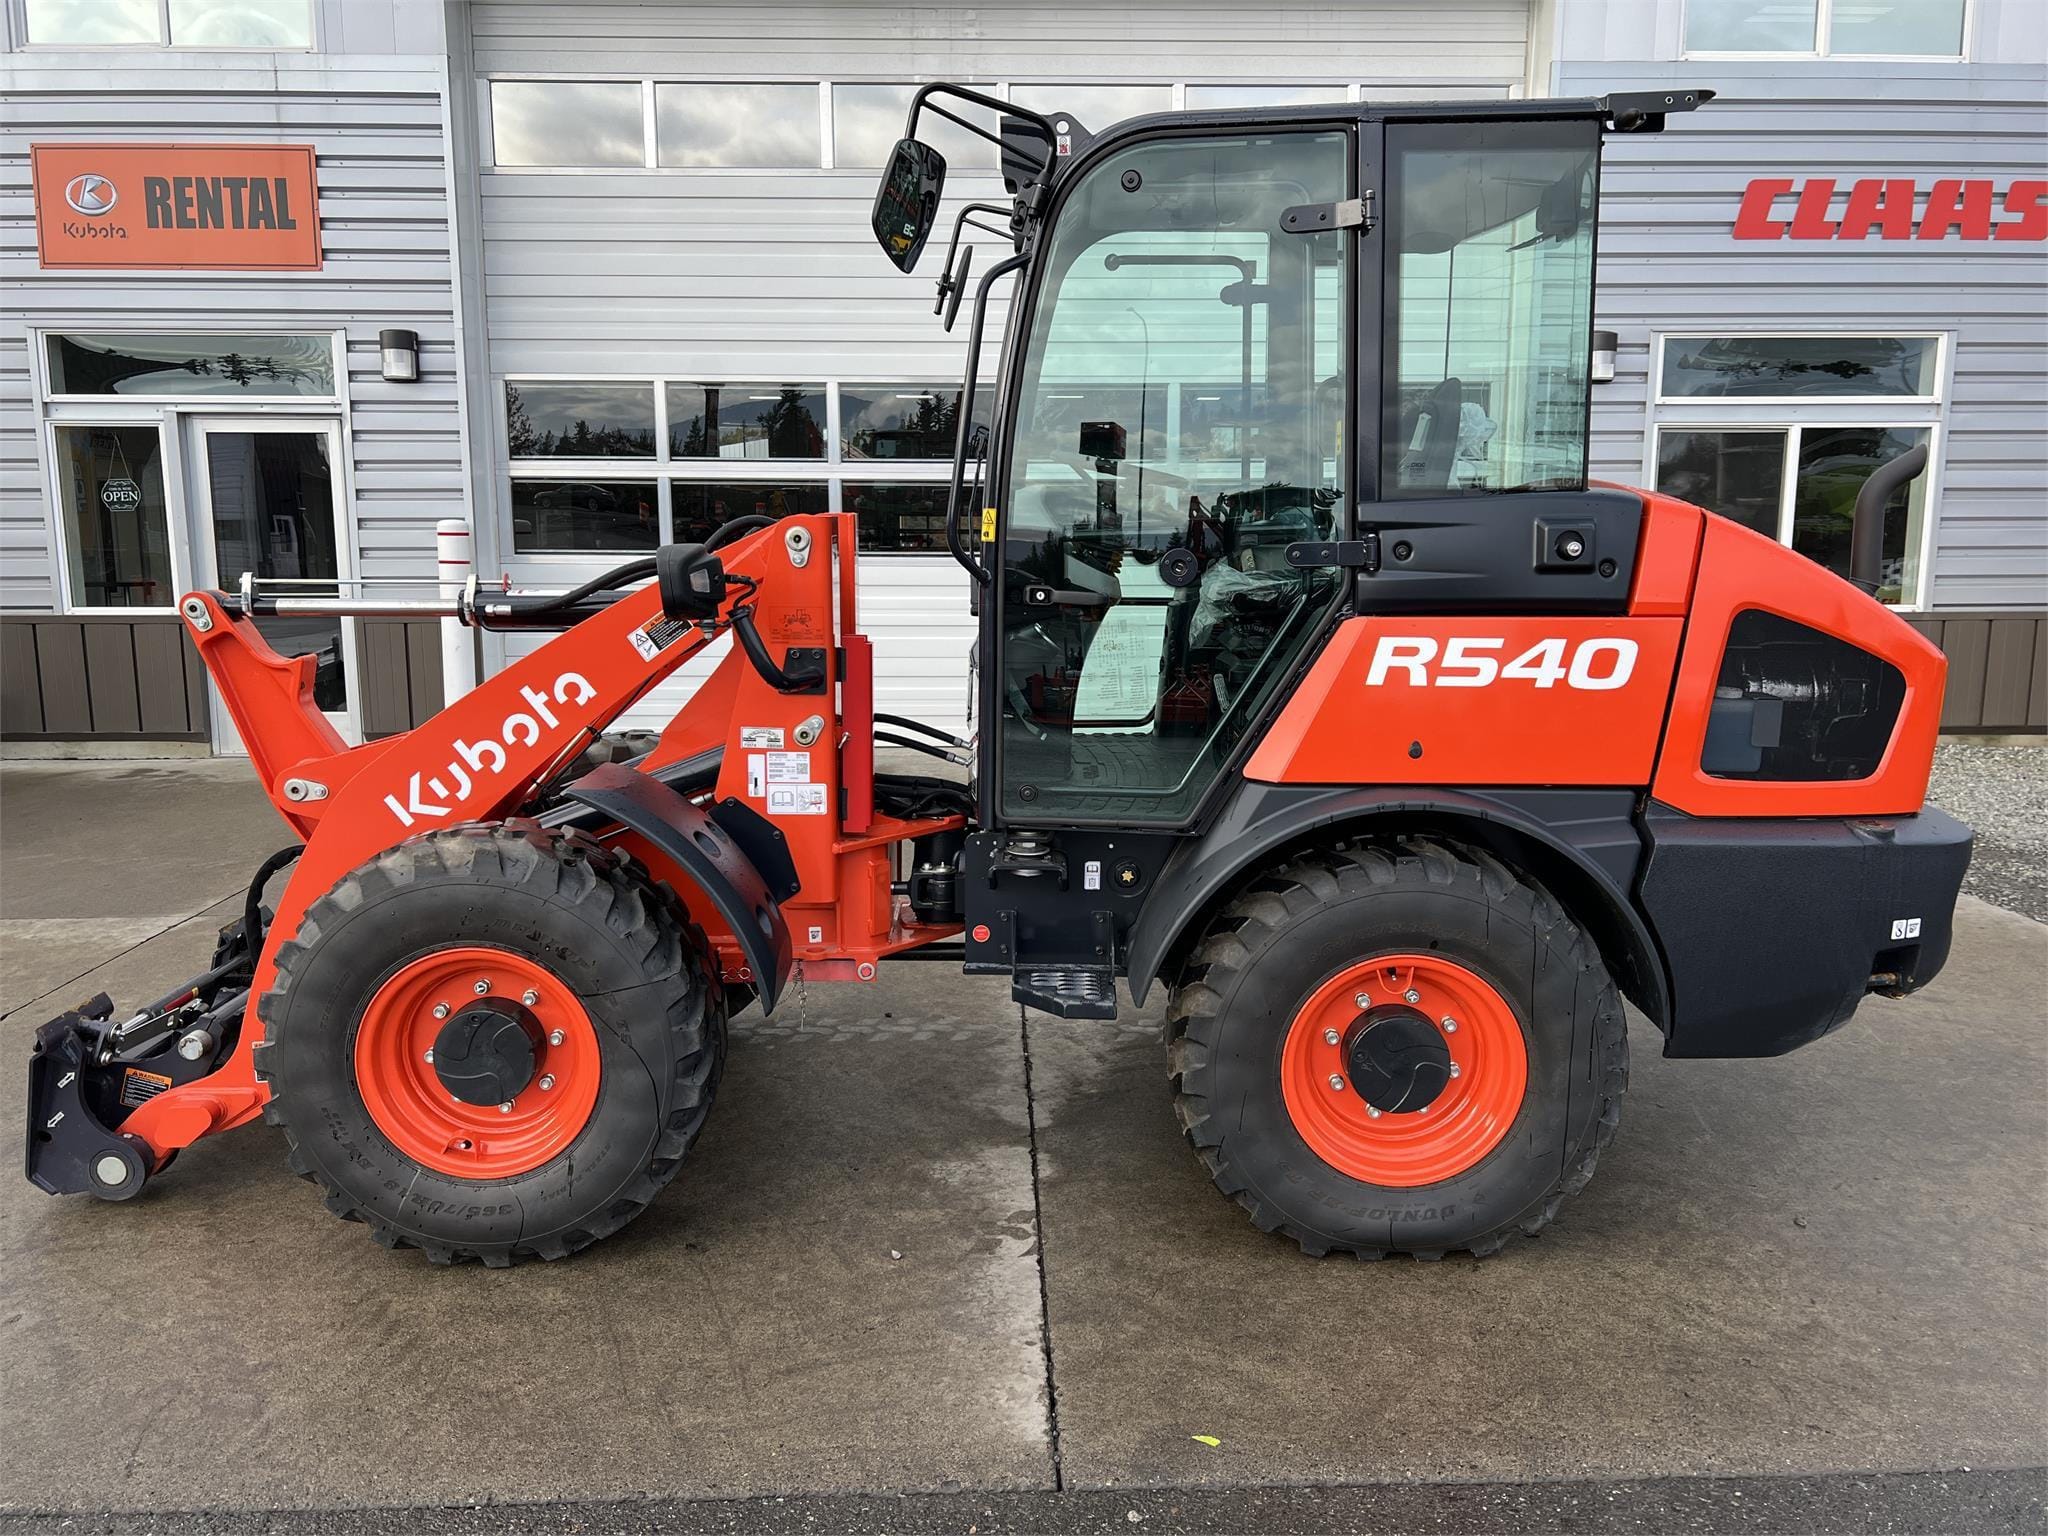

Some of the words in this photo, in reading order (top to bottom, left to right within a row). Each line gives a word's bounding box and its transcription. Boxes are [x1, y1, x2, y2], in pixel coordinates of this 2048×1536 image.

[143, 176, 297, 230] RENTAL
[1731, 178, 2048, 241] CLAAS
[63, 222, 127, 239] Kubota
[103, 490, 138, 503] OPEN
[1364, 636, 1640, 690] R540
[383, 671, 598, 828] Kubota
[1350, 1203, 1457, 1223] DUNLOP
